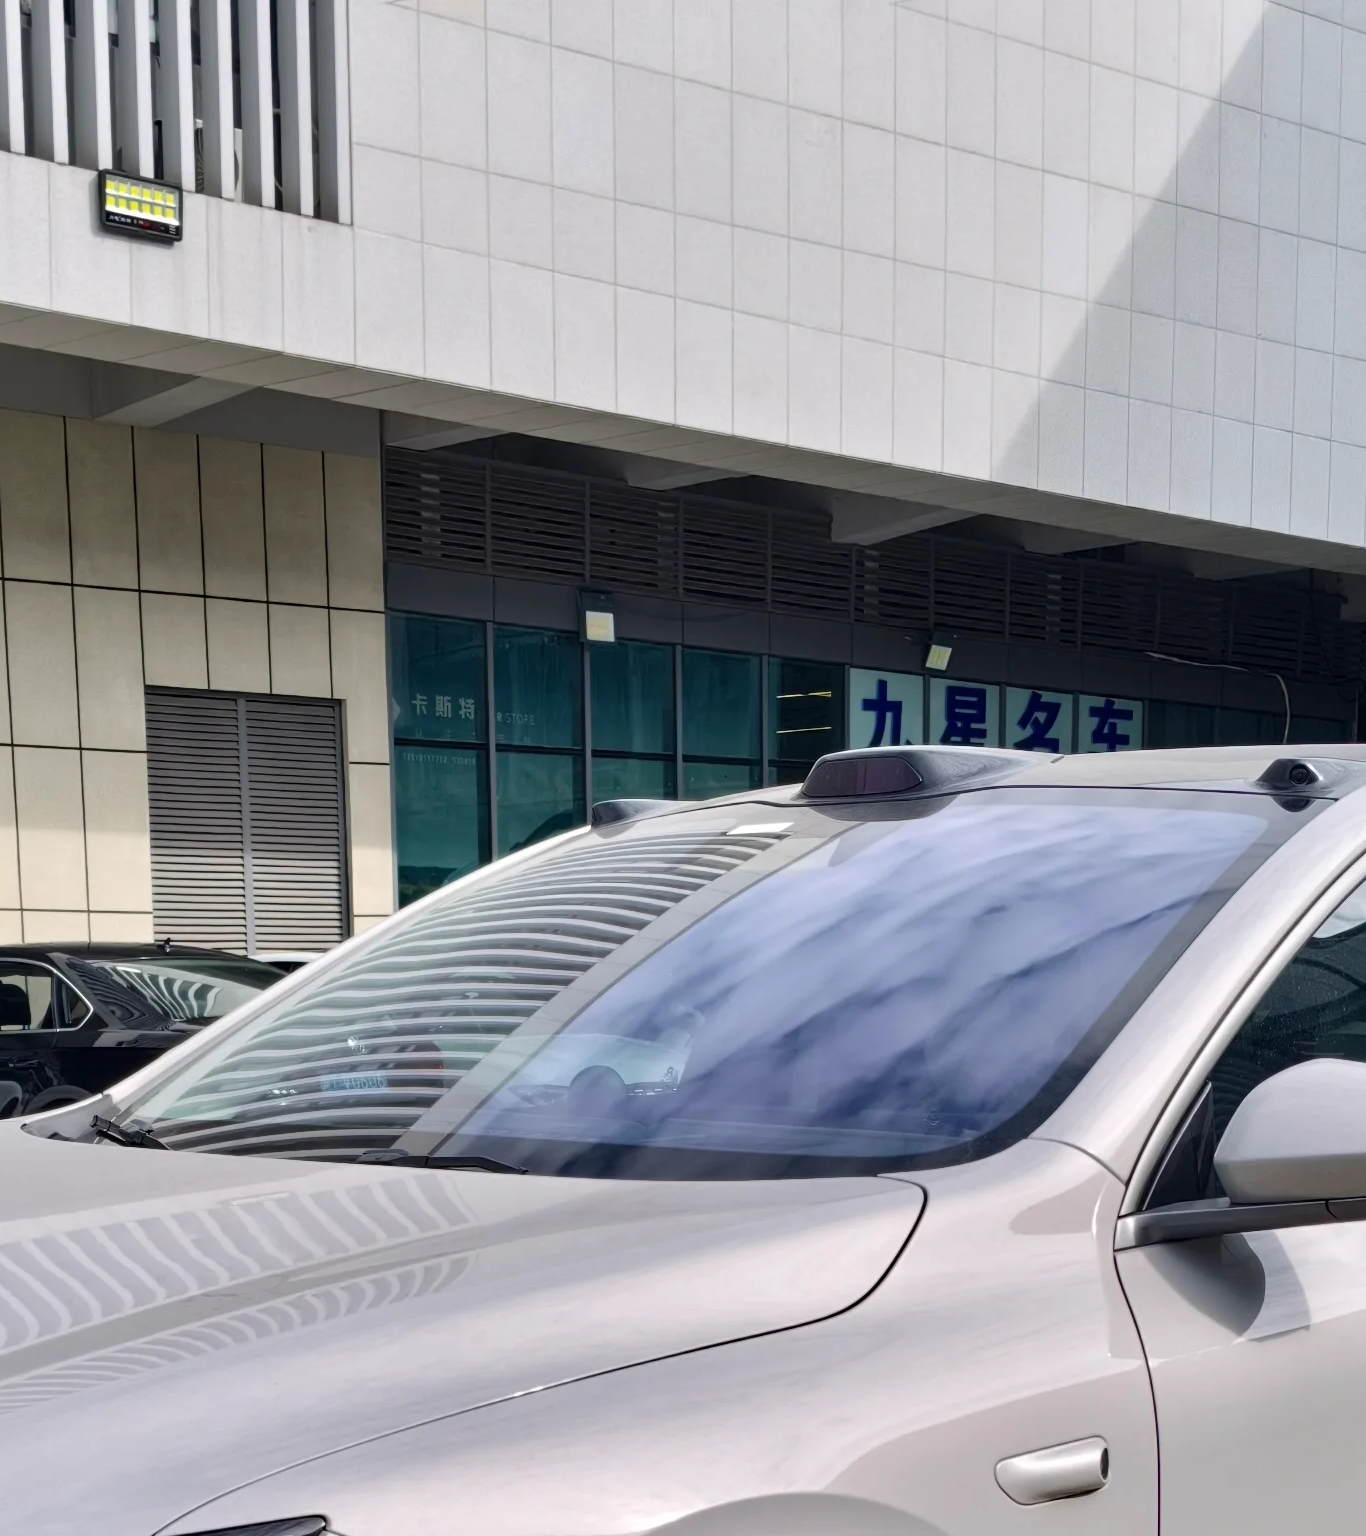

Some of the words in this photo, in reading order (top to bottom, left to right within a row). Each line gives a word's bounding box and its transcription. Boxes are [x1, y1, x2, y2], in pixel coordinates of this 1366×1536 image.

[411, 692, 475, 720] 卡斯特
[860, 679, 1134, 753] 九星名车
